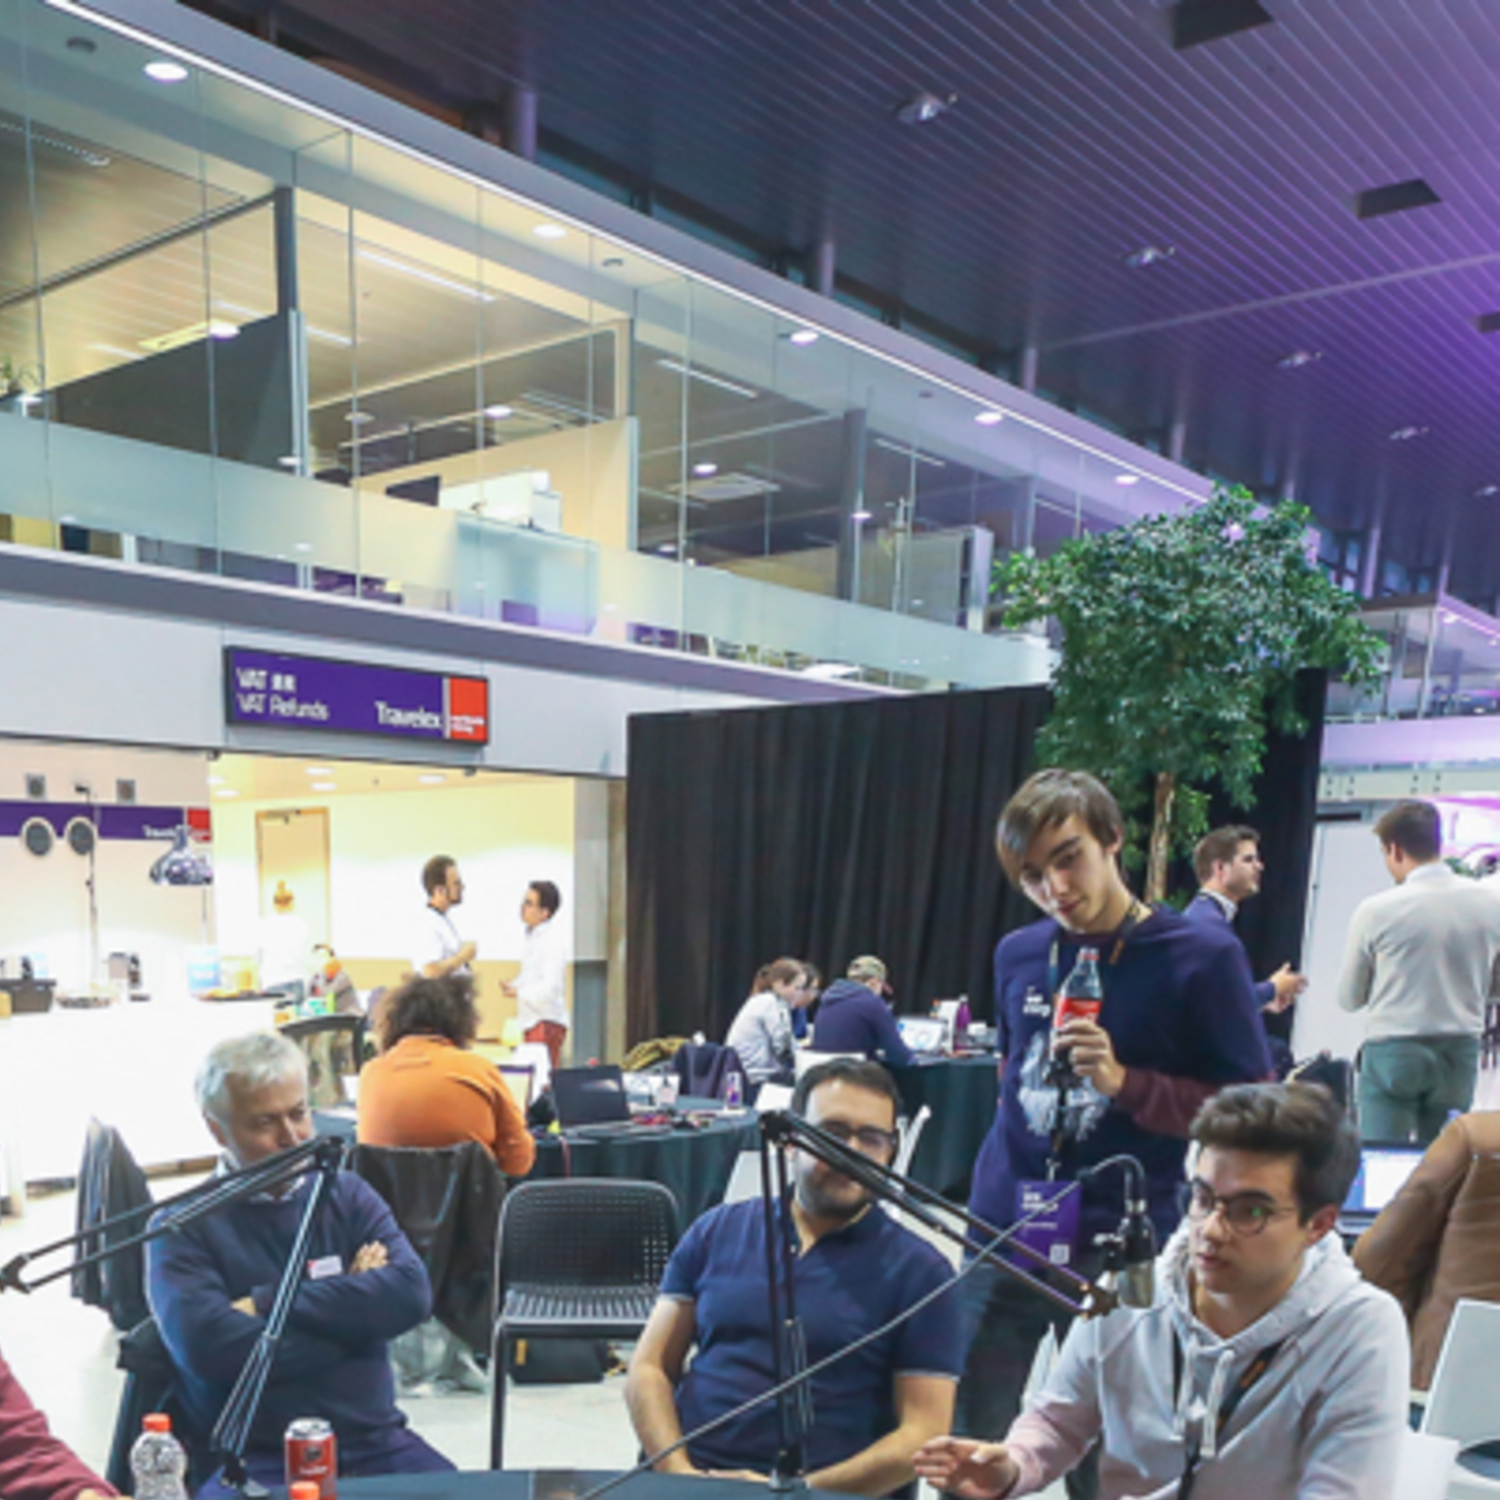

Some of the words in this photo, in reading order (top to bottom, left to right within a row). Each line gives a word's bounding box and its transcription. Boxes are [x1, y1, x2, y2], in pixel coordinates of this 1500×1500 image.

[236, 667, 267, 690] VAT
[236, 693, 267, 713] VAT
[270, 694, 330, 721] Refunds
